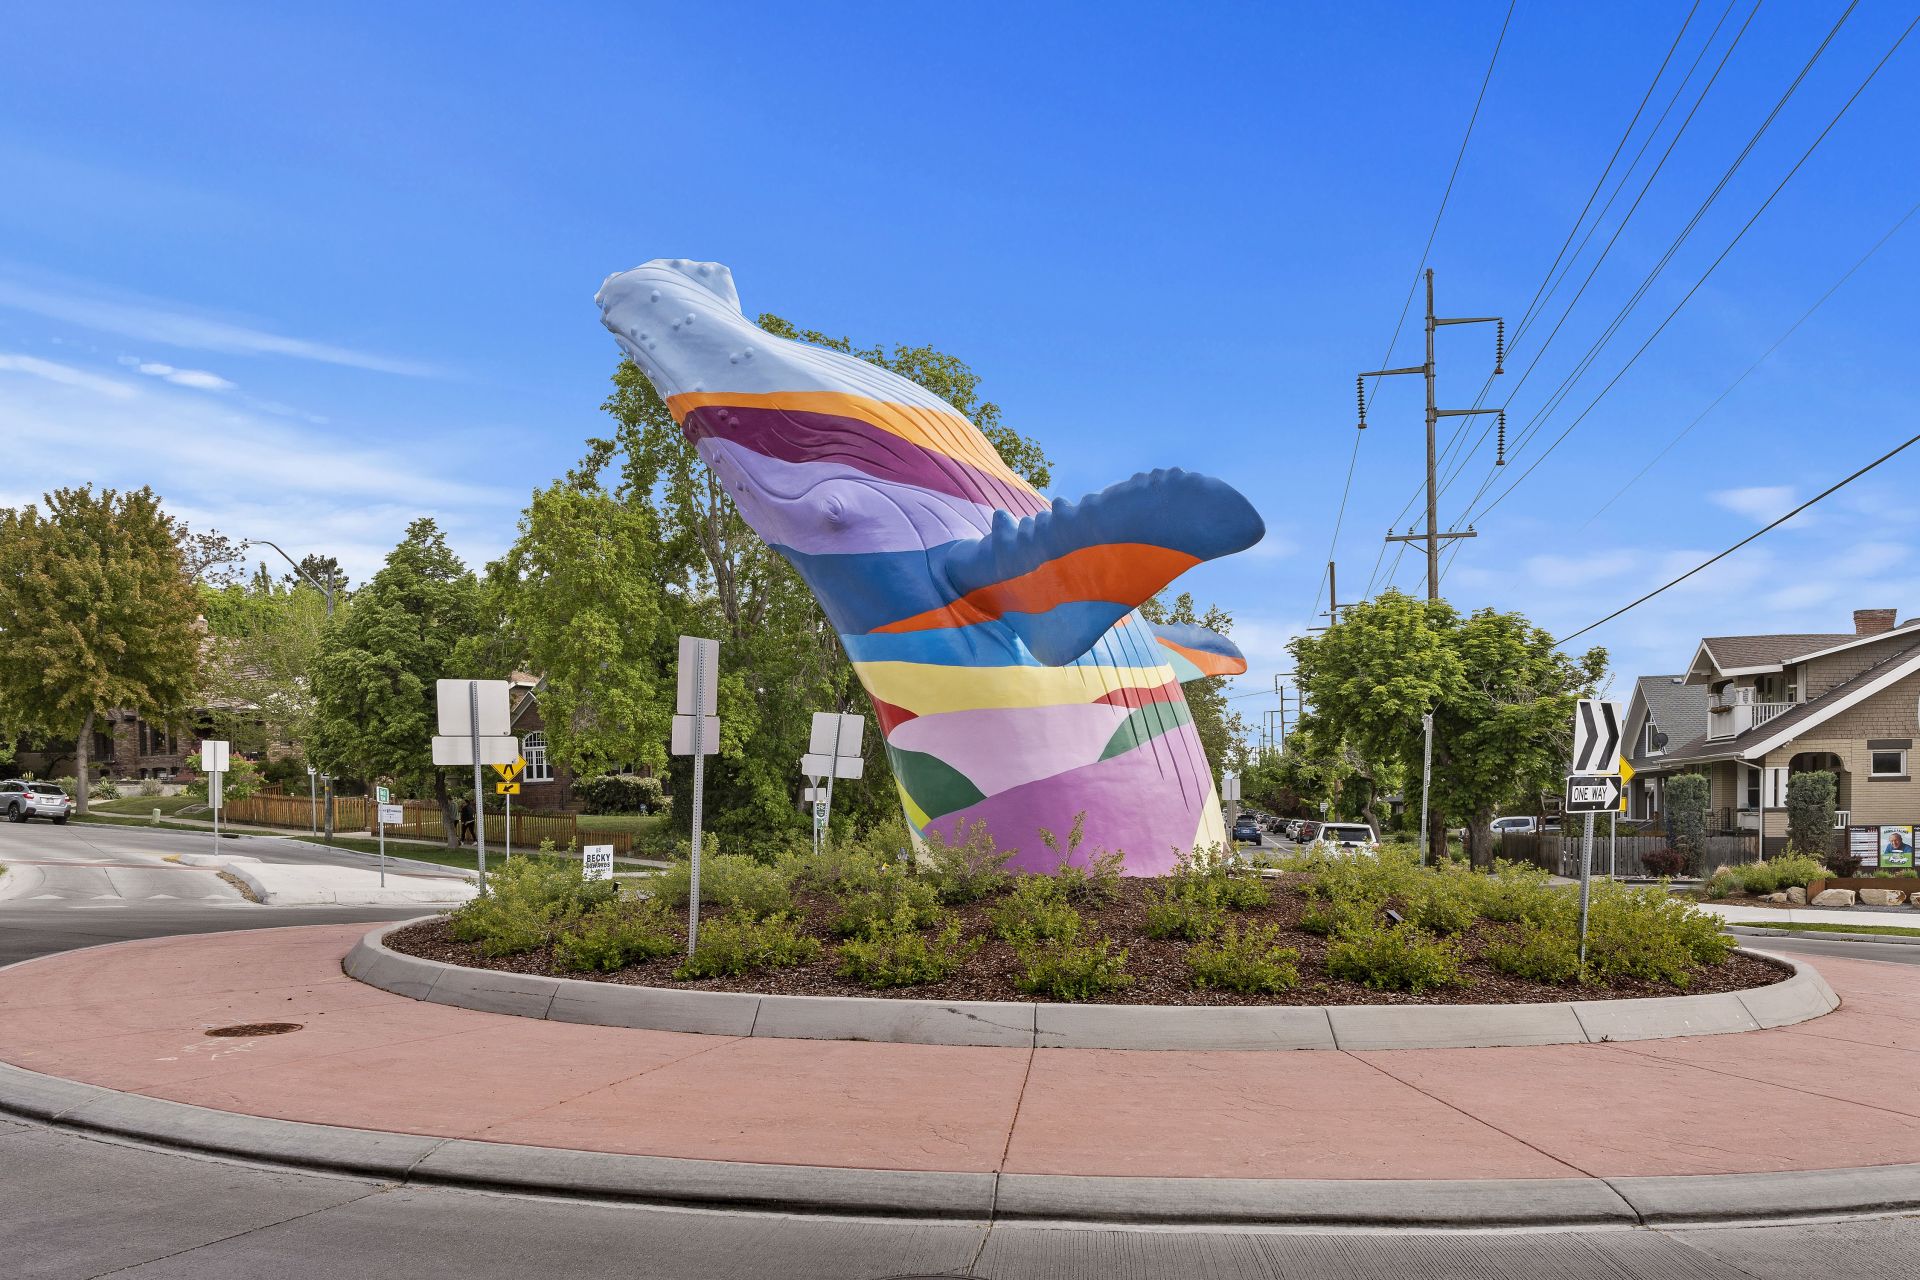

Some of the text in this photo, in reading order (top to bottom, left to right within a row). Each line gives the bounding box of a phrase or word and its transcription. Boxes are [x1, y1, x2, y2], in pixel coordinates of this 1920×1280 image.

[1574, 787, 1607, 800] ONE WAY
[586, 853, 611, 862] BECKY
